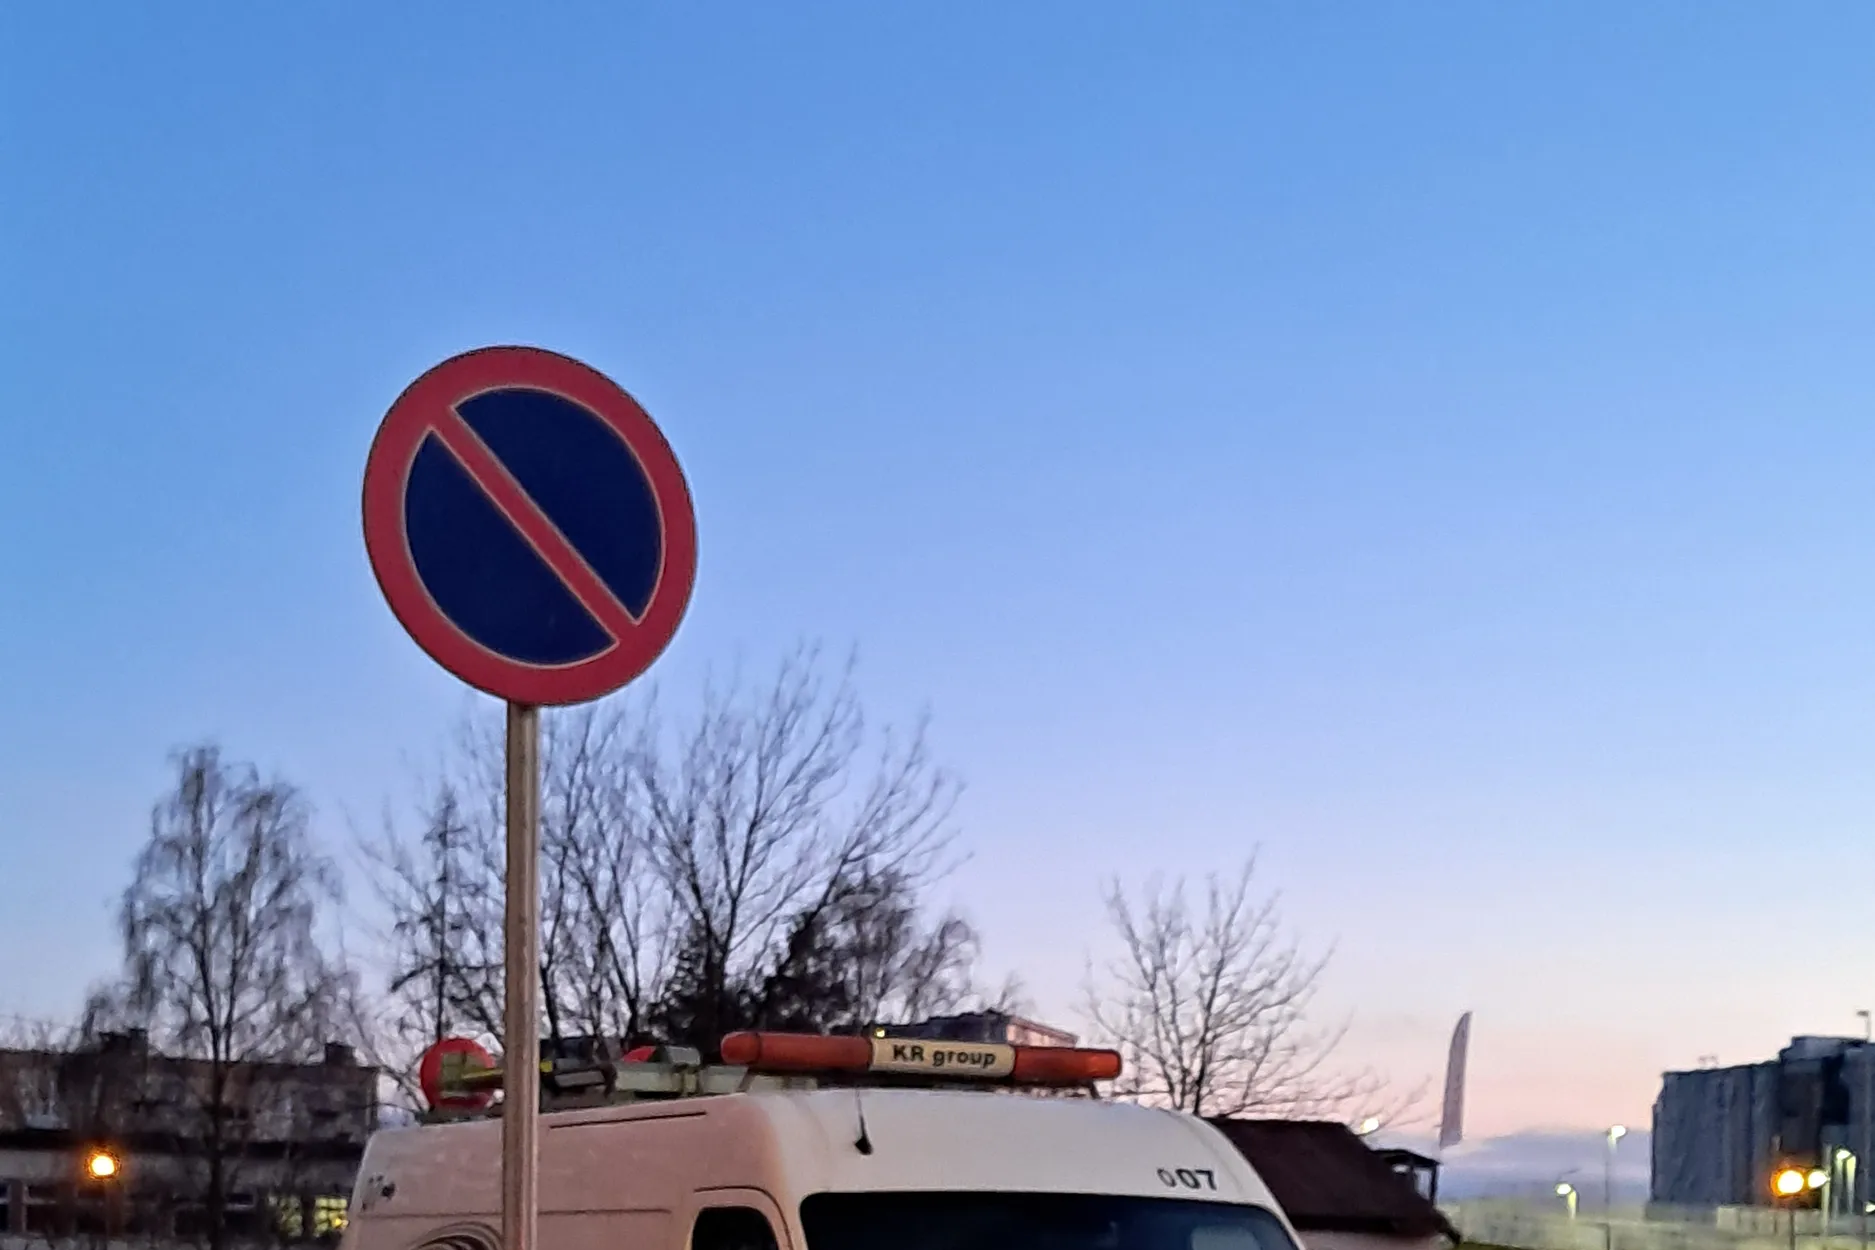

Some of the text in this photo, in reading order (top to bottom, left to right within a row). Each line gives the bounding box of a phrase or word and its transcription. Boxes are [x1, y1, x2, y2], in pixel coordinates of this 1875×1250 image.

[892, 1044, 996, 1069] KR group
[1156, 1168, 1218, 1191] 007
